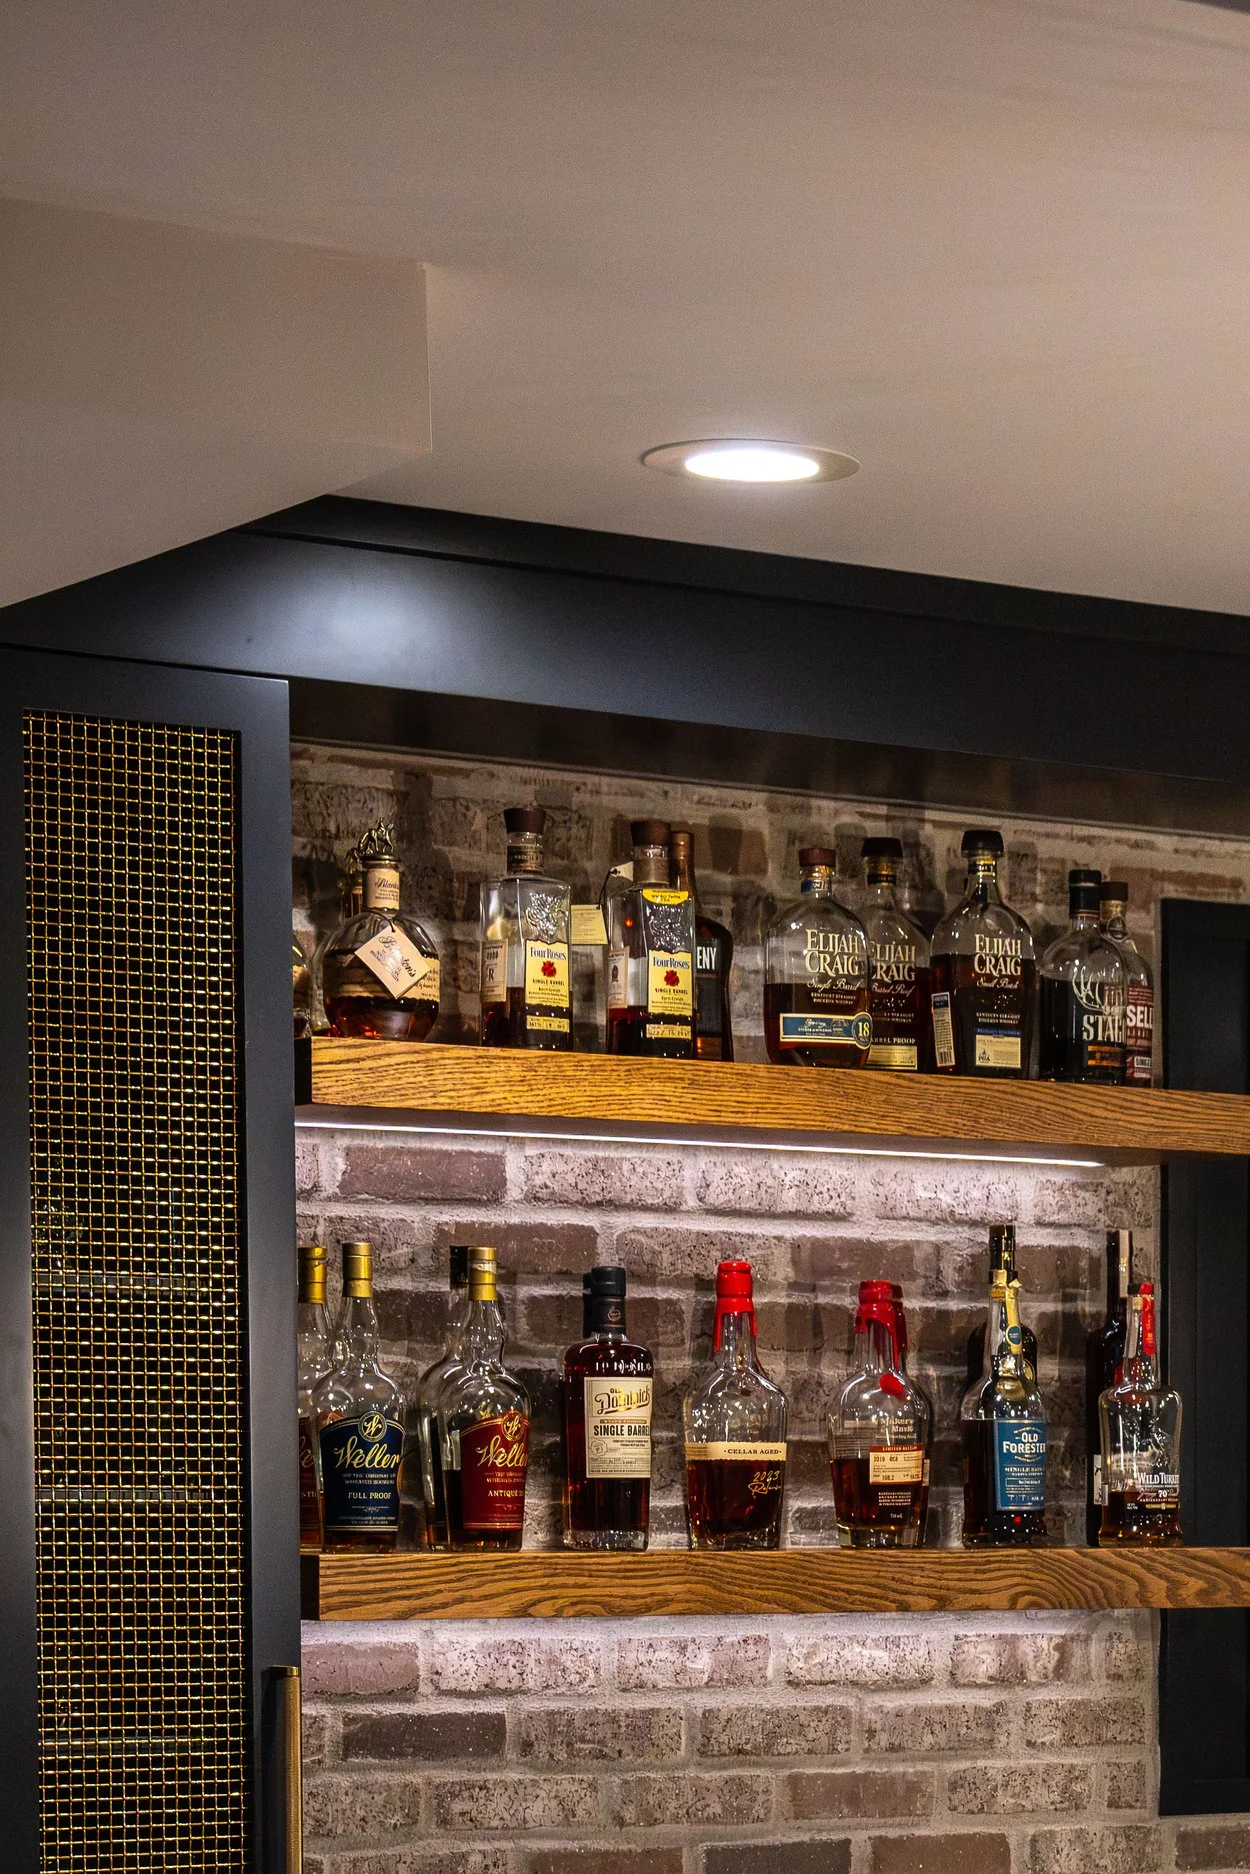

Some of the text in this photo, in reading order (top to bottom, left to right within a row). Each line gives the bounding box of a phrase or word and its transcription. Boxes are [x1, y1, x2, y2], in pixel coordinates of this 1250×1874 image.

[805, 929, 859, 955] ELIJAH
[974, 933, 1021, 957] ELIJAH
[530, 946, 567, 961] Four Roses
[652, 956, 690, 969] Four Roses
[696, 946, 717, 970] ENY
[805, 950, 859, 977] CRAIG
[973, 953, 1021, 977] CRAIG
[1126, 1004, 1153, 1029] SELL
[857, 1021, 870, 1037] 18
[593, 1425, 650, 1437] SINGLE BARREL
[1021, 1432, 1039, 1443] OLD
[333, 1435, 400, 1469] Weller
[1002, 1441, 1046, 1454] FORESTE
[1137, 1471, 1180, 1485] WILD TURKE
